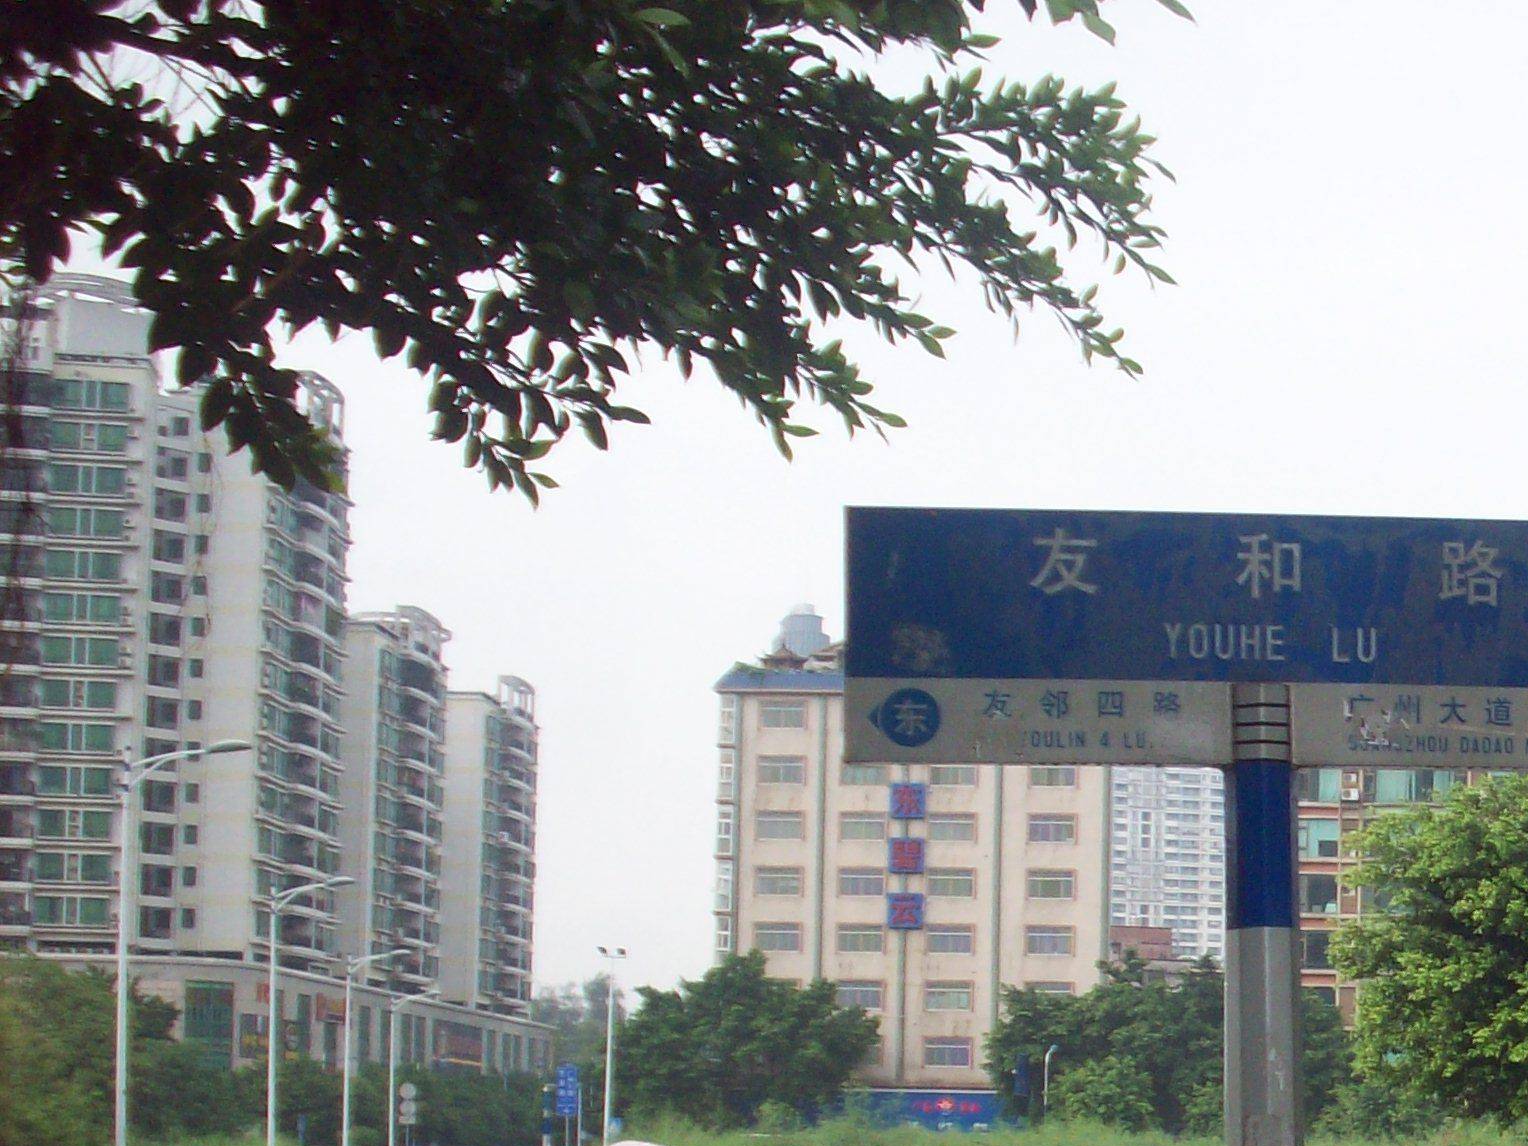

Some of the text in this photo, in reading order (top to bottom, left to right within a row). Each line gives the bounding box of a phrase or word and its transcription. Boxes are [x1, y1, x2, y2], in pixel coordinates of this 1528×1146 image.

[1029, 527, 1502, 608] 友和路
[1163, 622, 1379, 665] YOUHE LU
[894, 697, 929, 736] 东
[982, 689, 1182, 720] 友邻四路
[1021, 729, 1086, 749] OULIN
